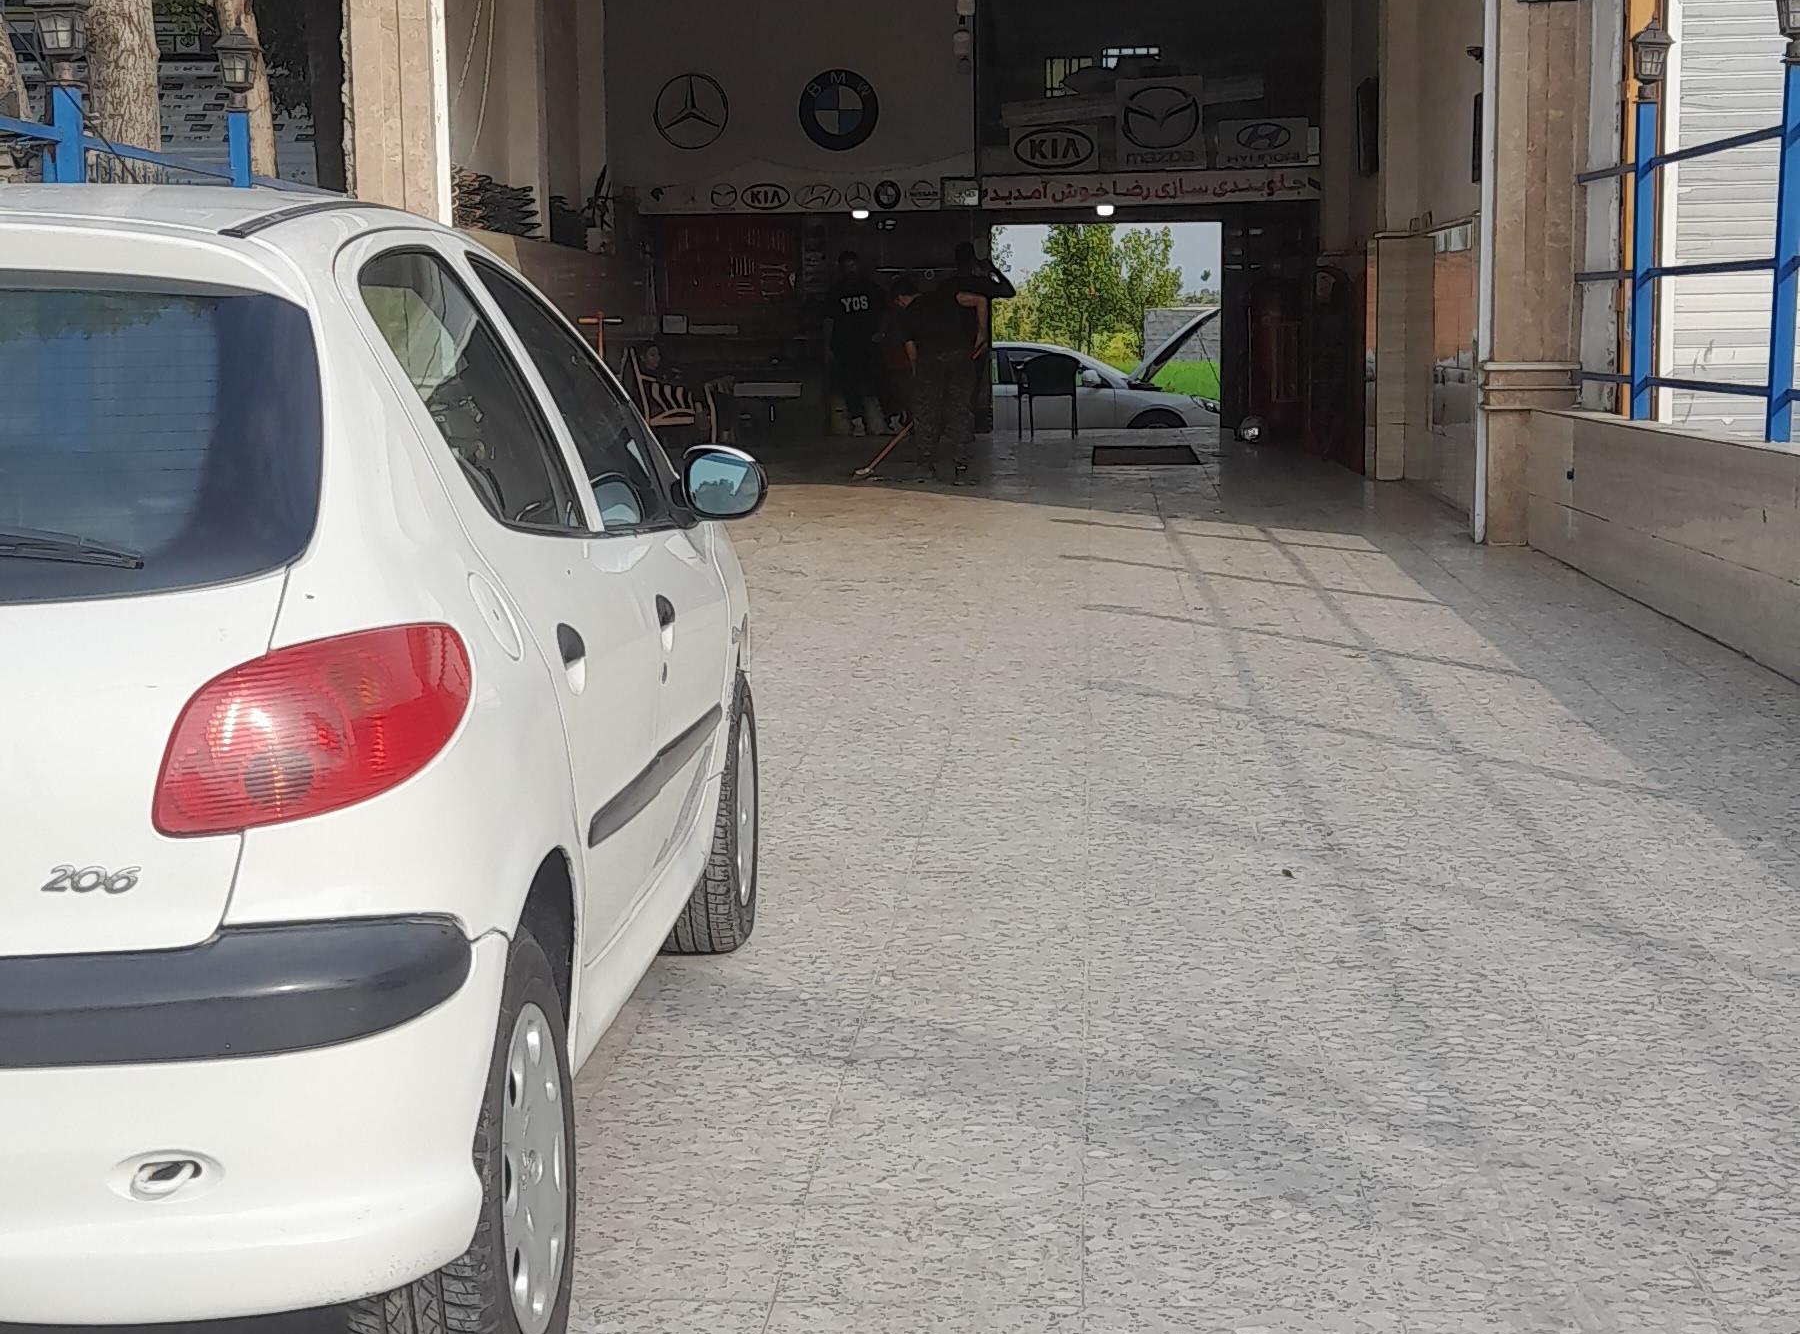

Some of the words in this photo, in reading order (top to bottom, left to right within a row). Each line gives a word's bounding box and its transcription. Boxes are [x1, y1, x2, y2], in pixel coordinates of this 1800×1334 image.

[1029, 137, 1081, 160] KIA
[750, 190, 782, 204] KIA
[40, 864, 142, 895] 206
